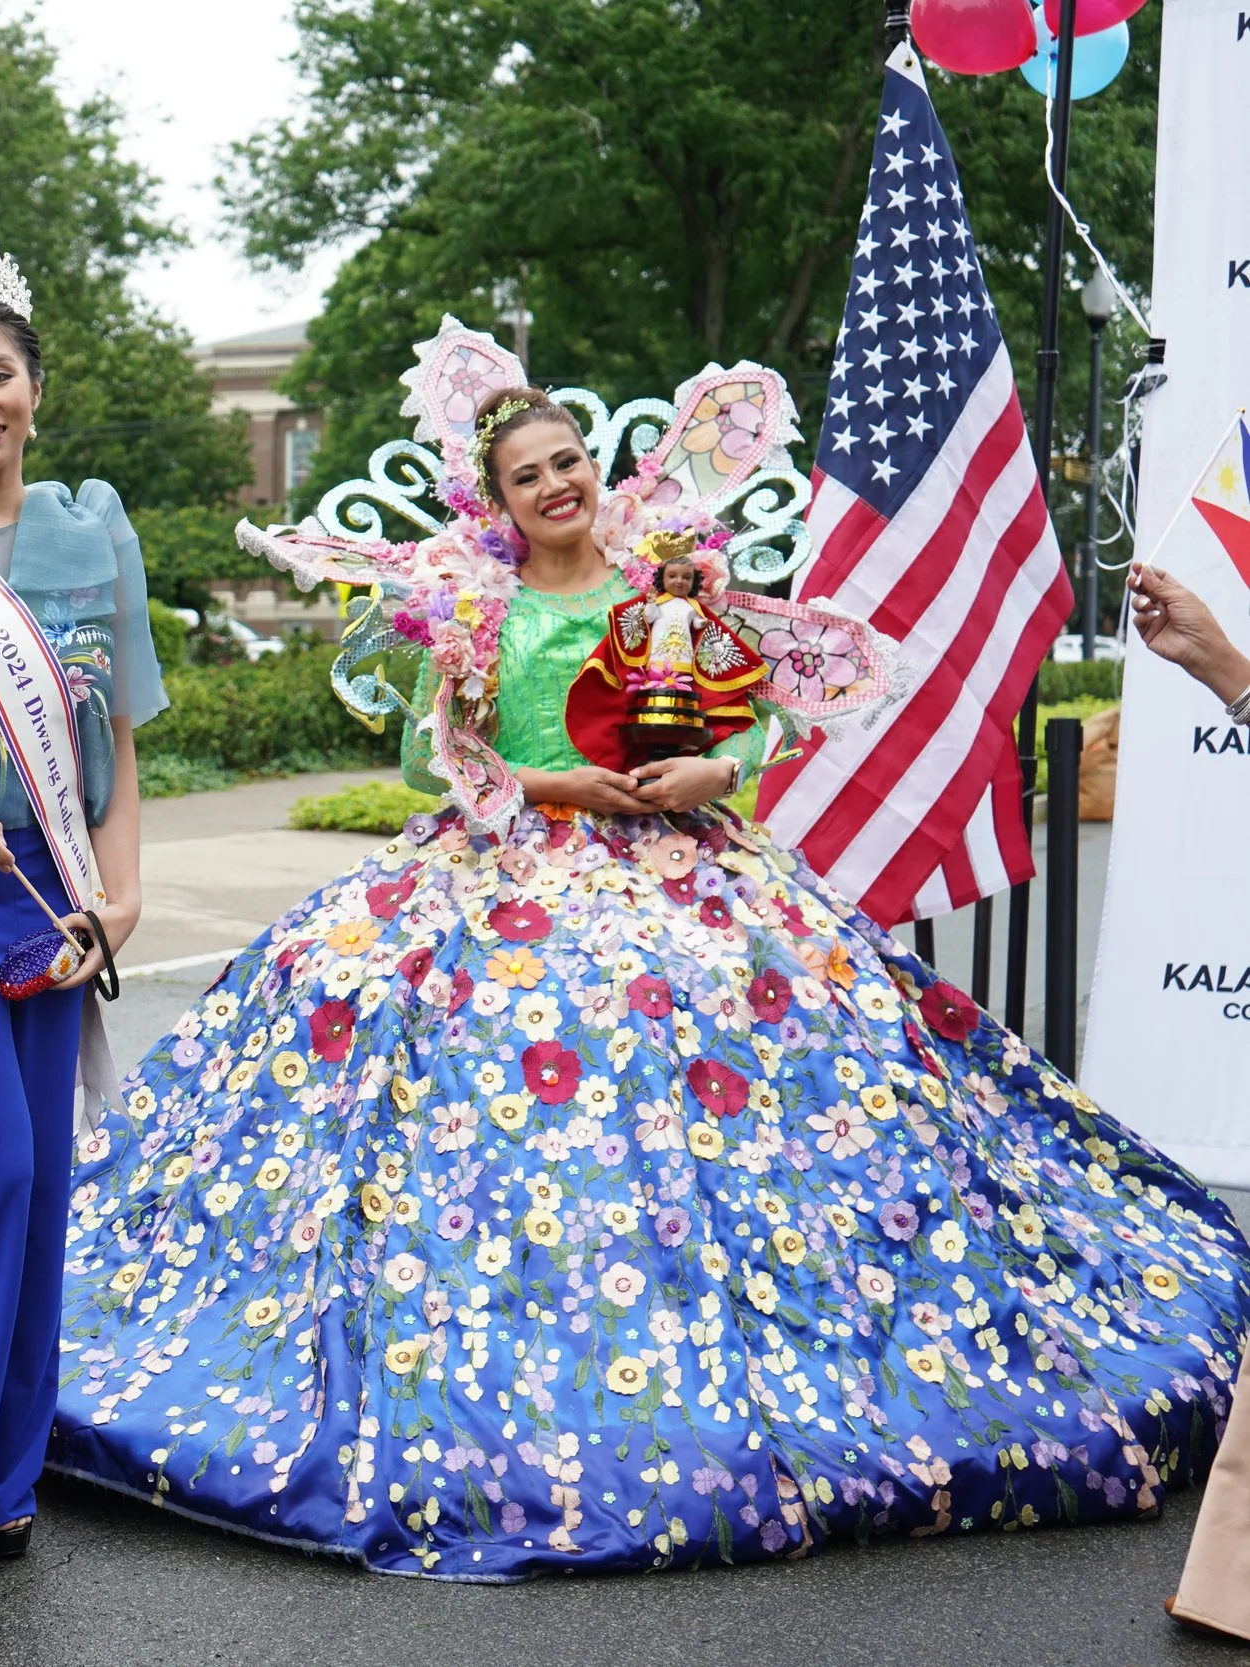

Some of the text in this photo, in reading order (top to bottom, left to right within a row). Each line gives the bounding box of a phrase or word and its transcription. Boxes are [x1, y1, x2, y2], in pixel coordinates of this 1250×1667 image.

[24, 694, 52, 753] Diwa
[47, 757, 62, 787] ng
[57, 784, 88, 878] Kalayaan
[1193, 726, 1250, 755] KA
